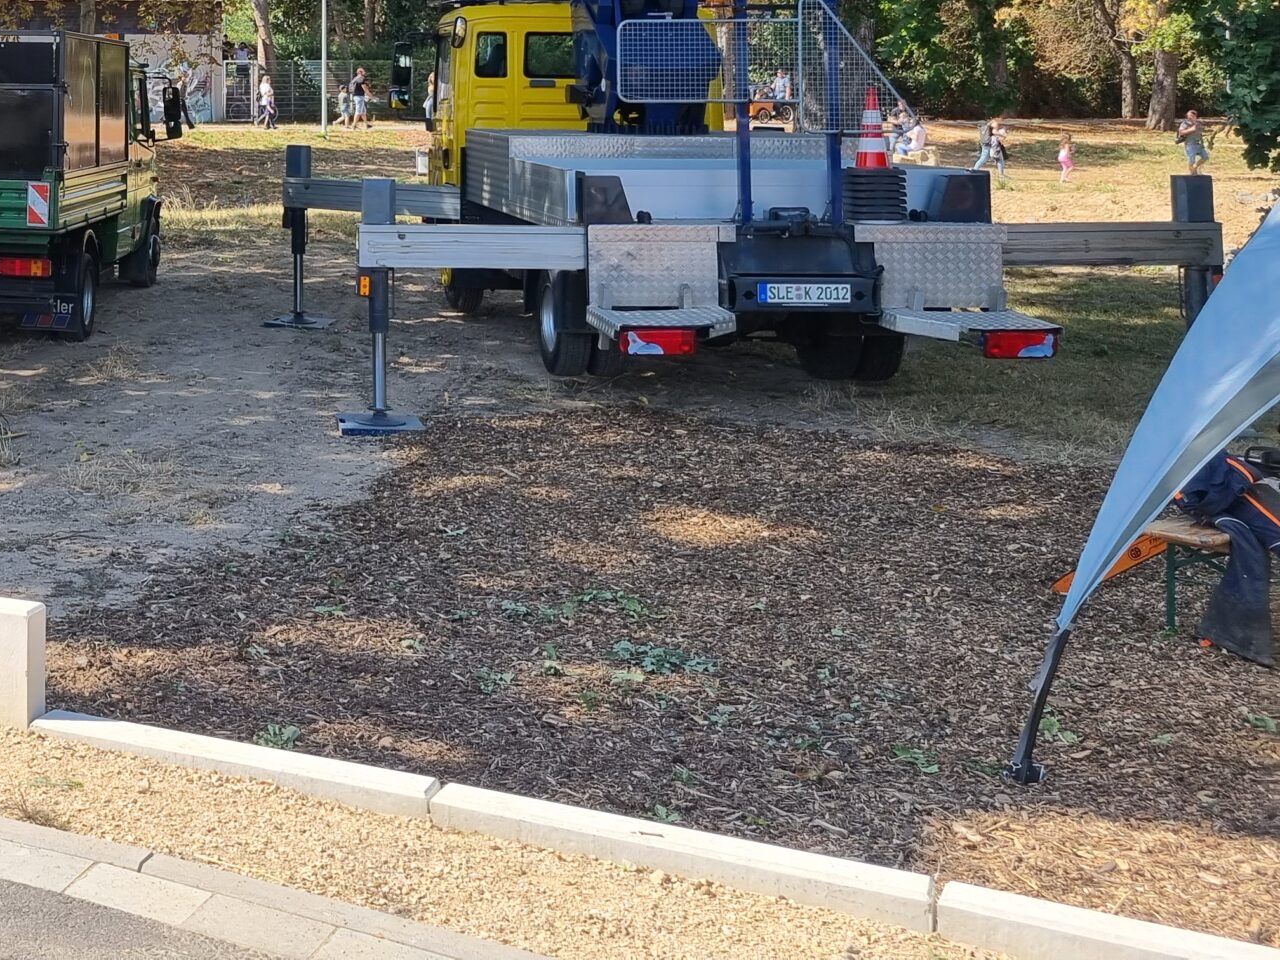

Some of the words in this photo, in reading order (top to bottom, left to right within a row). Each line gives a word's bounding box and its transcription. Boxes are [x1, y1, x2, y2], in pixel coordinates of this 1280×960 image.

[768, 286, 794, 300] SLE
[804, 286, 813, 300] K
[816, 286, 849, 301] 2012
